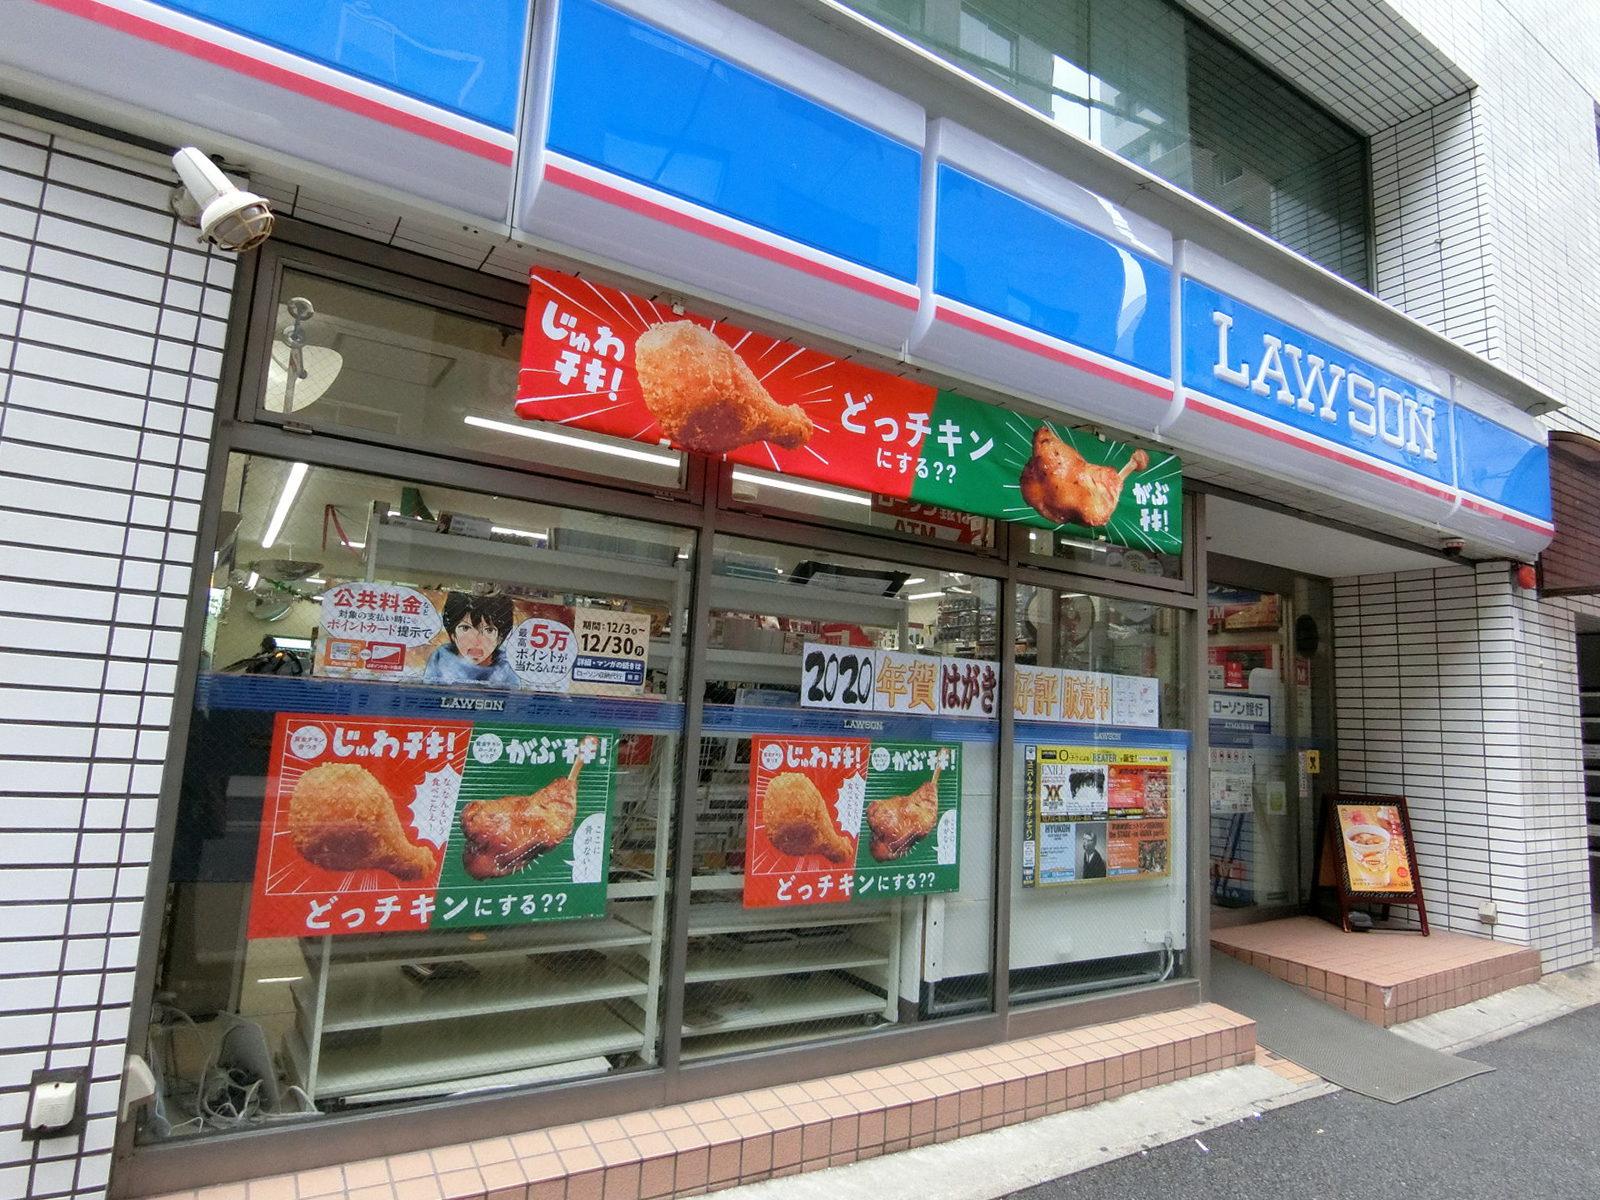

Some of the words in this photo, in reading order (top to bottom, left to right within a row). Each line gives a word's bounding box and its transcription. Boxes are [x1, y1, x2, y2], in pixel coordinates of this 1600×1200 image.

[541, 301, 625, 362] じゅわ
[554, 350, 623, 402] チキ!
[1213, 310, 1438, 463] LAWSON
[841, 392, 994, 462] どっチキン
[876, 448, 957, 484] にする??
[1132, 481, 1170, 505] がぶ
[1139, 508, 1169, 532] チキ!
[333, 588, 422, 615] 公共料金
[327, 619, 432, 638] ポイントカード提示で
[517, 628, 528, 648] 最高
[530, 624, 570, 651] 5万
[516, 649, 568, 663] ポイントが
[804, 650, 872, 704] 2020
[876, 655, 937, 711] 年賀
[942, 663, 997, 713] はがき
[1062, 675, 1110, 720] 販売中
[440, 697, 504, 711] LAWSON
[1213, 700, 1264, 717] ローソン銀行
[843, 719, 883, 730] LAWSON
[333, 727, 456, 760] じゅわチキ!
[505, 736, 608, 765] がぶチキ!
[787, 744, 861, 769] じゅわチキ!
[892, 749, 956, 772] がぶチキ!
[776, 872, 936, 901] どっチキンにする??
[305, 892, 568, 930] どっチキンにする??
